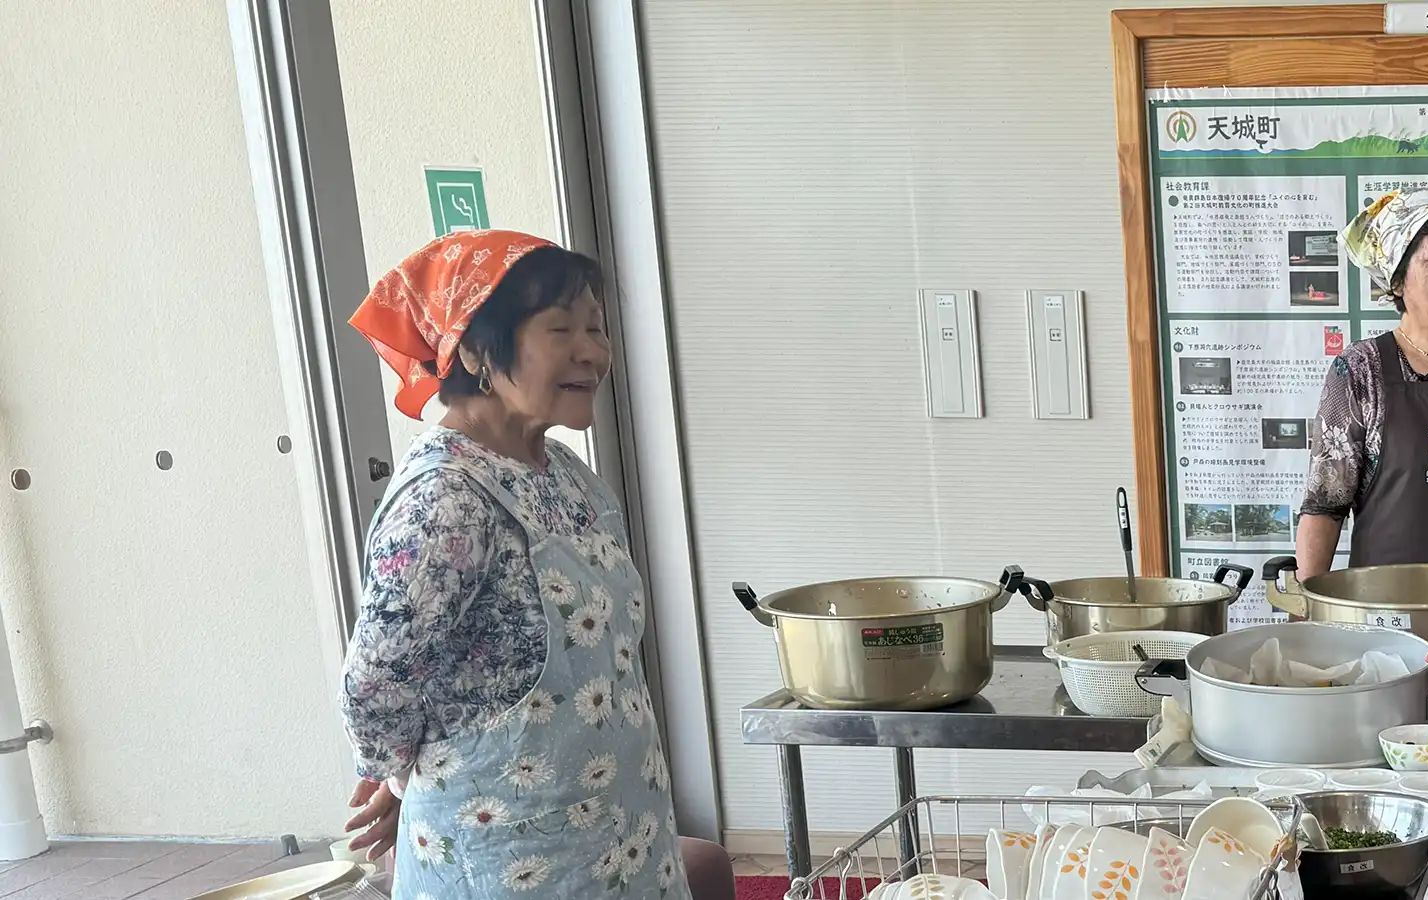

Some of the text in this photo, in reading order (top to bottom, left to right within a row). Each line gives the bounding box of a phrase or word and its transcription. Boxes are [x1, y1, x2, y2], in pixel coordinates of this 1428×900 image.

[1208, 114, 1281, 140] 天城町
[1166, 181, 1210, 191] 社会教育課
[1174, 326, 1199, 336] 文化財
